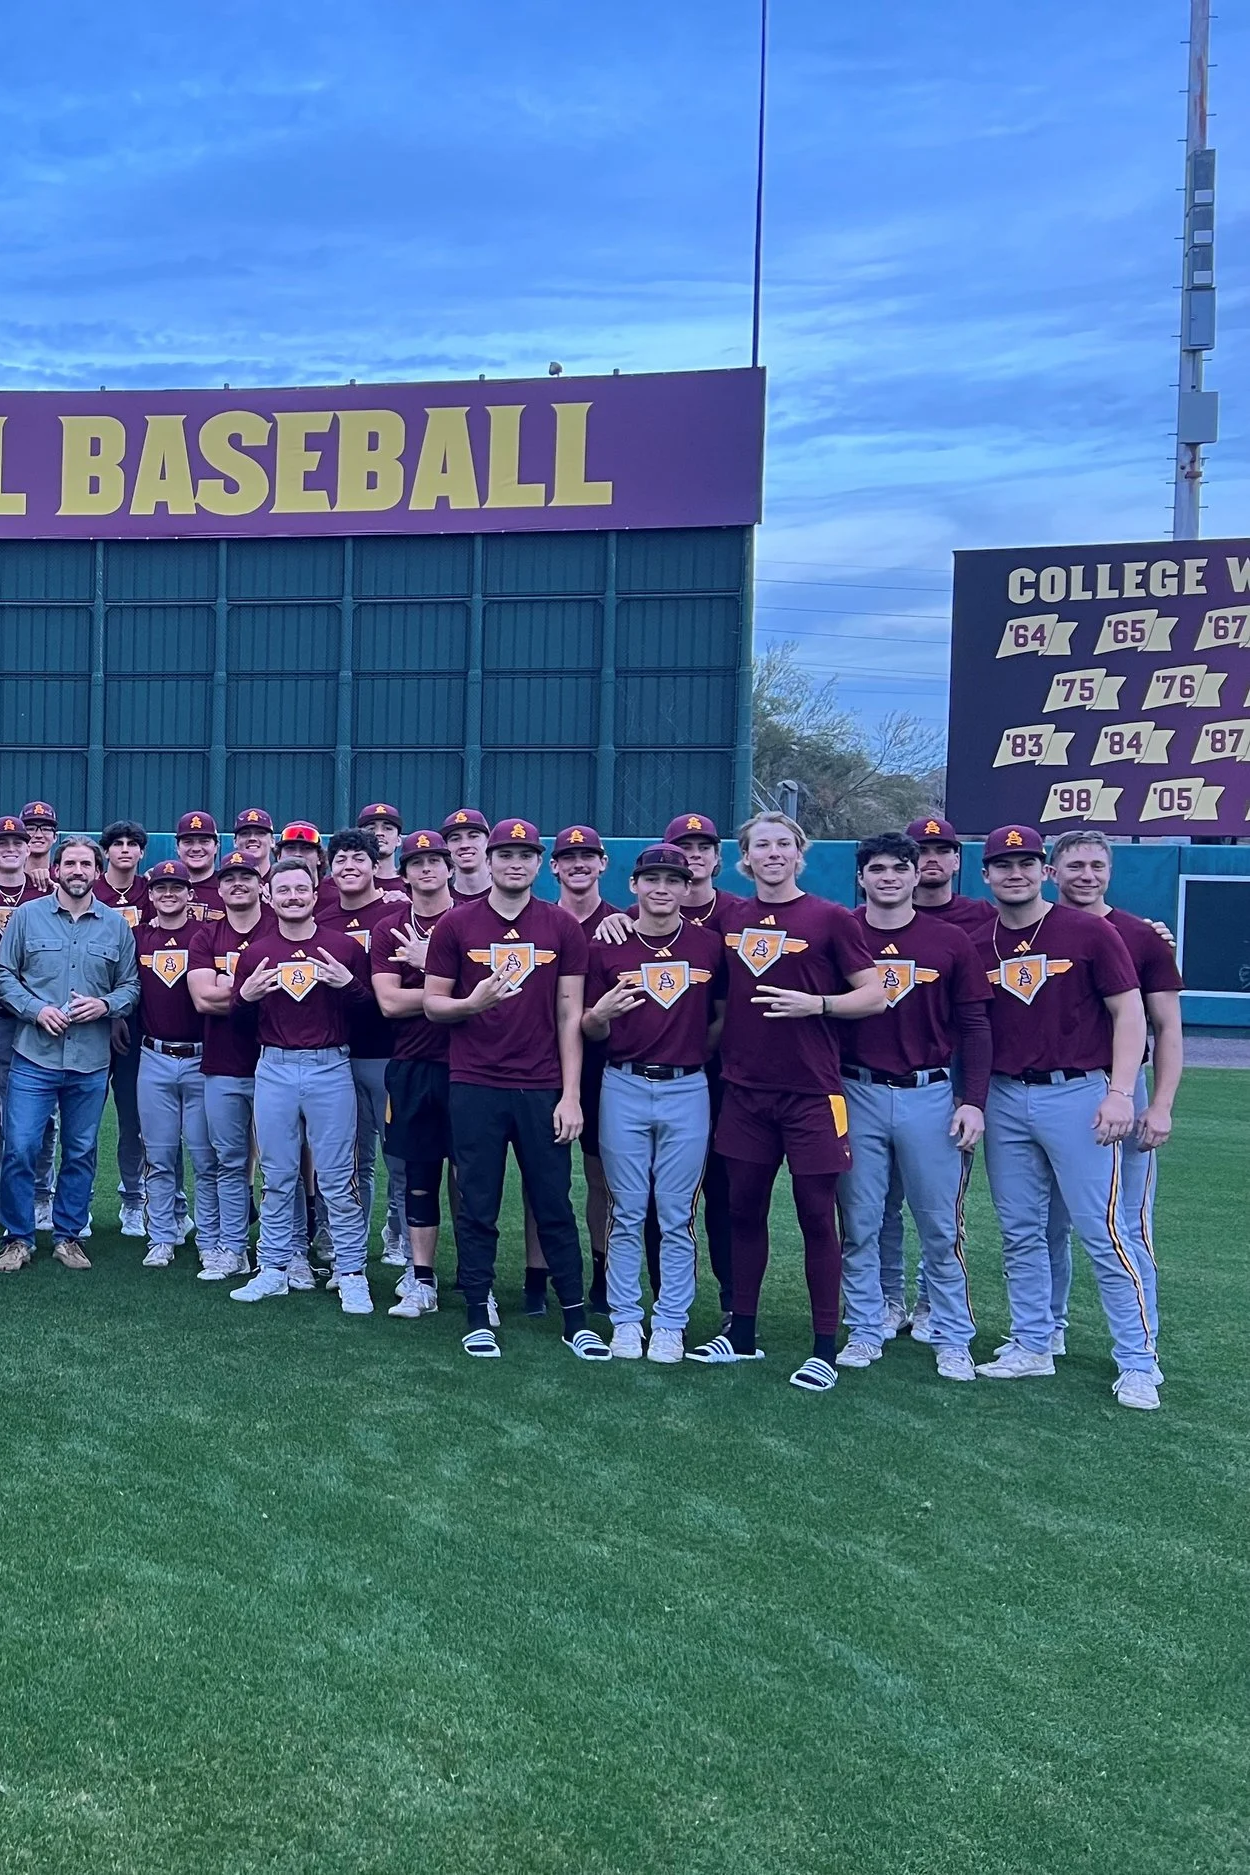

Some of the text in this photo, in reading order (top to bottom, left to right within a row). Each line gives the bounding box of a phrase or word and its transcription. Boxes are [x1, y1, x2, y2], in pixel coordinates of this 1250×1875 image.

[55, 401, 613, 515] BASEBALL
[1008, 558, 1208, 604] COLLEGE
[1008, 615, 1248, 648] '64 '65 '67
[1055, 674, 1196, 702] '75 '76
[1005, 727, 1245, 757] '83 '84 '87
[1053, 786, 1193, 812] '98 '05
